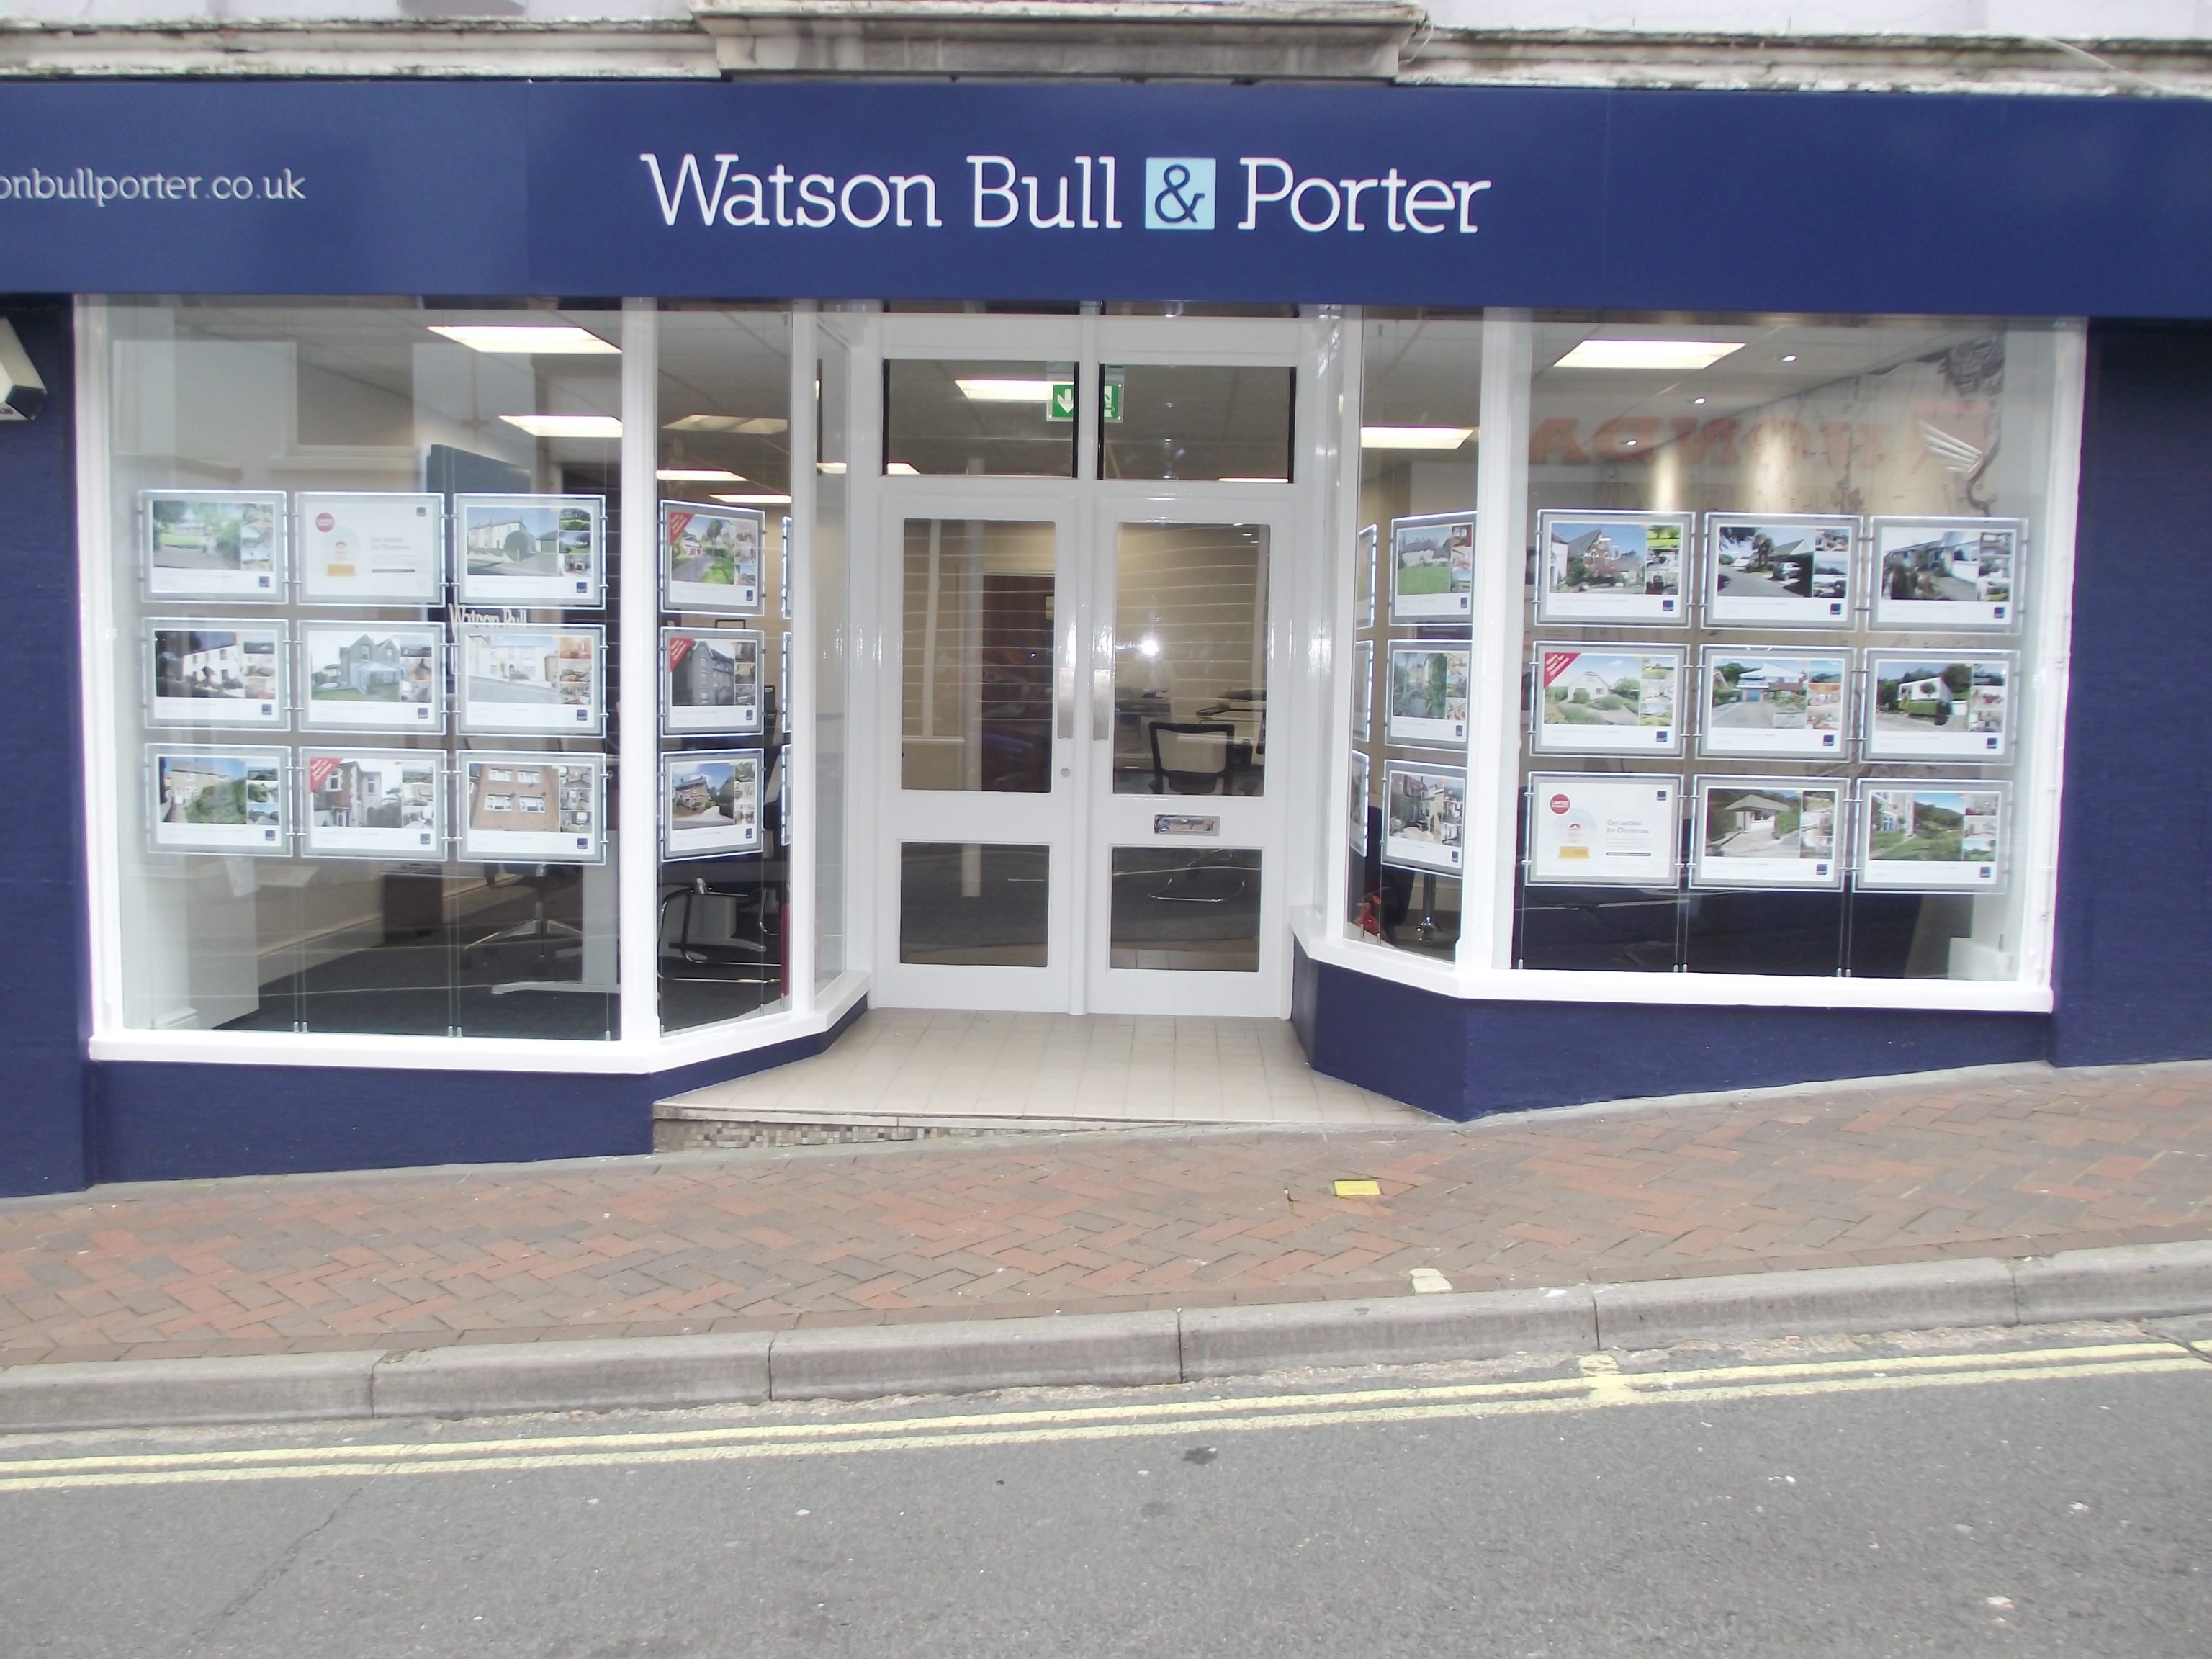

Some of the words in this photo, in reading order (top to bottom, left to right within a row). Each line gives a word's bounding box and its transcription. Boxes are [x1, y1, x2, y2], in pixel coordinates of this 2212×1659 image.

[639, 153, 943, 228] Watson
[966, 155, 1123, 228] Bull
[1154, 163, 1205, 224] &
[1237, 157, 1491, 233] Porter
